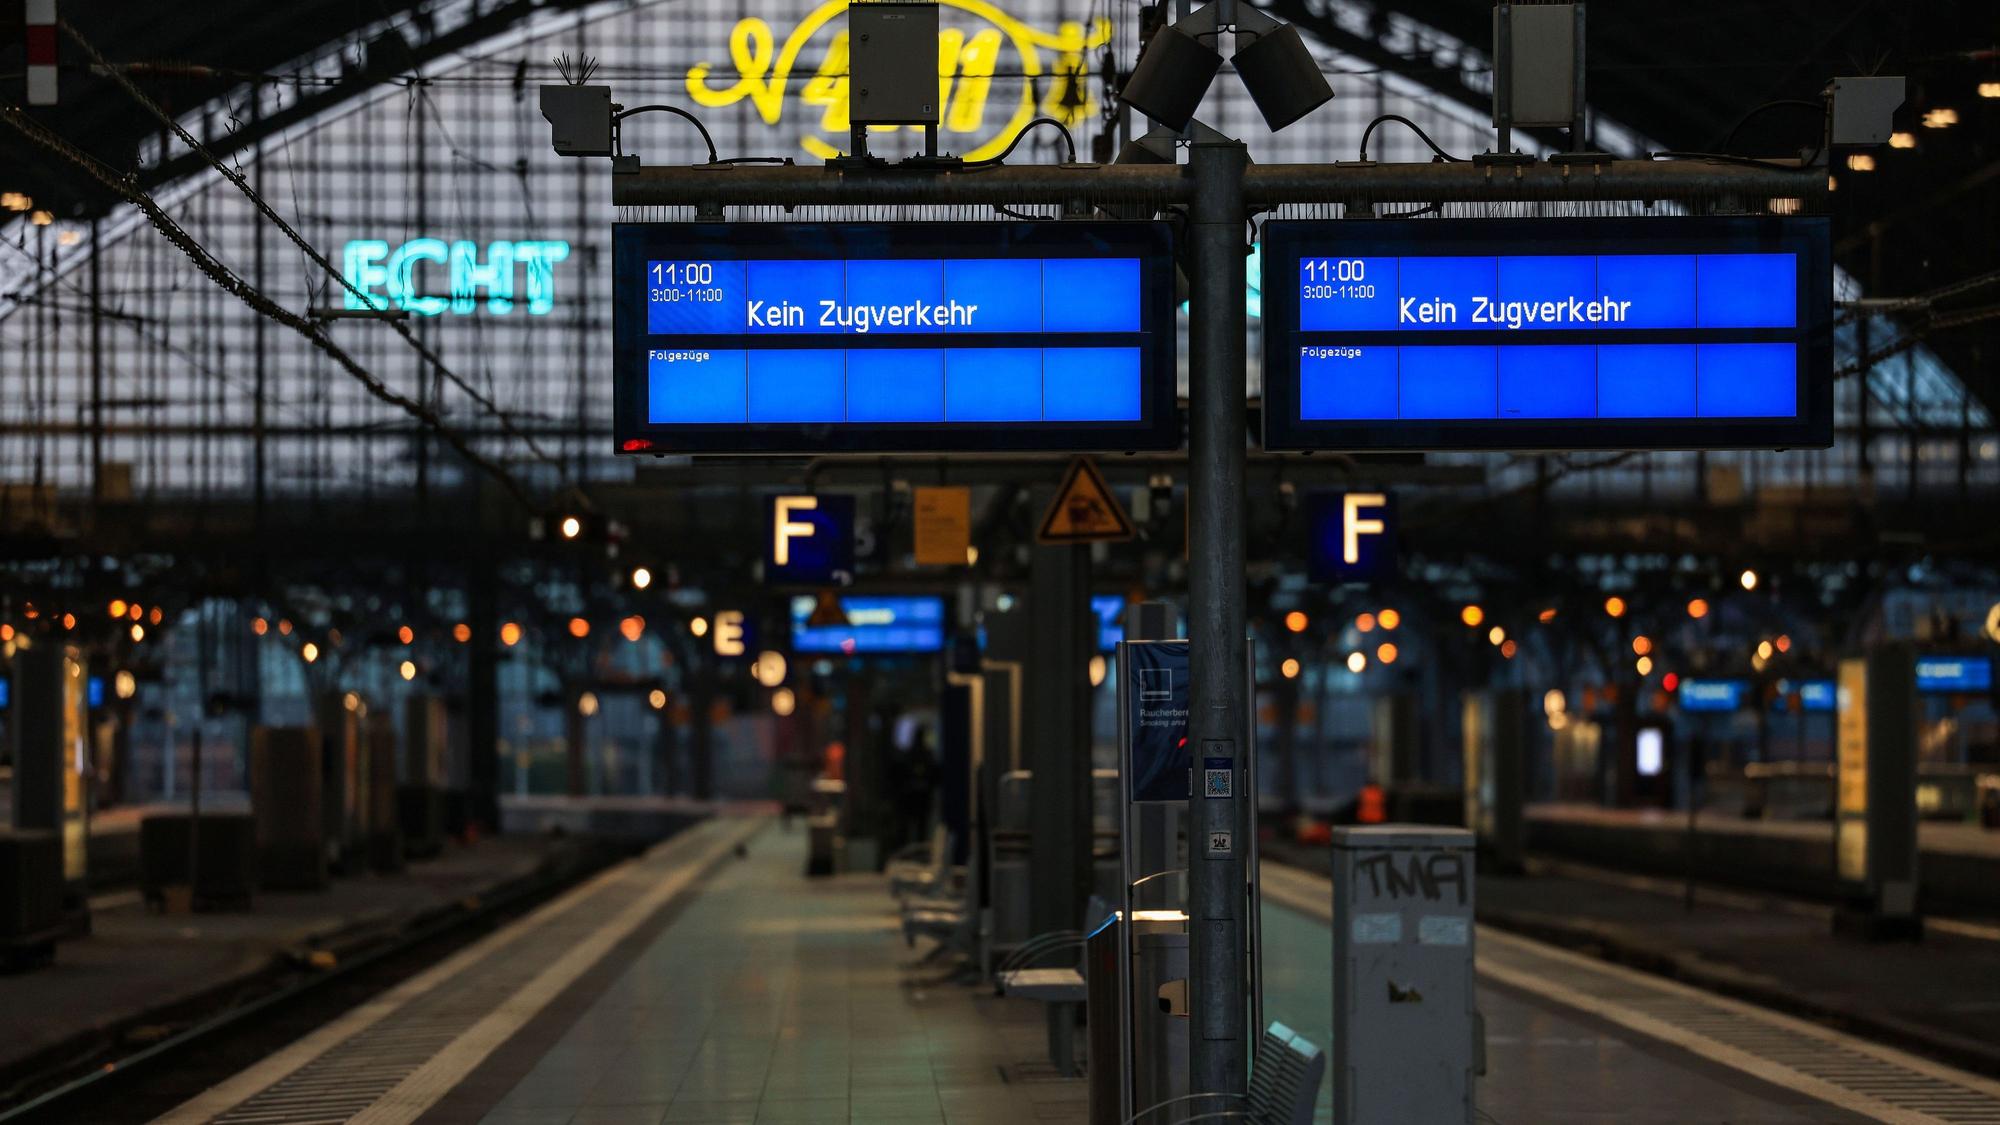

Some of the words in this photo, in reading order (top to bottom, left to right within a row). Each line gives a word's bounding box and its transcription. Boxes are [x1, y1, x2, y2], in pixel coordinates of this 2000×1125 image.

[343, 238, 570, 317] ECHT
[651, 262, 712, 286] 11:00
[1303, 258, 1365, 283] 11:00
[650, 287, 723, 303] 3:00-11:00
[1302, 283, 1375, 300] 3:00-11:00
[747, 300, 804, 328] Kein
[819, 299, 978, 333] Zugverkehr
[1399, 295, 1457, 324] Kein
[1471, 294, 1632, 330] Zugverkehr
[649, 350, 710, 363] Folgezüge
[1301, 346, 1362, 359] Folgezüge
[774, 496, 818, 566] F
[1343, 493, 1387, 564] F
[714, 611, 745, 656] E
